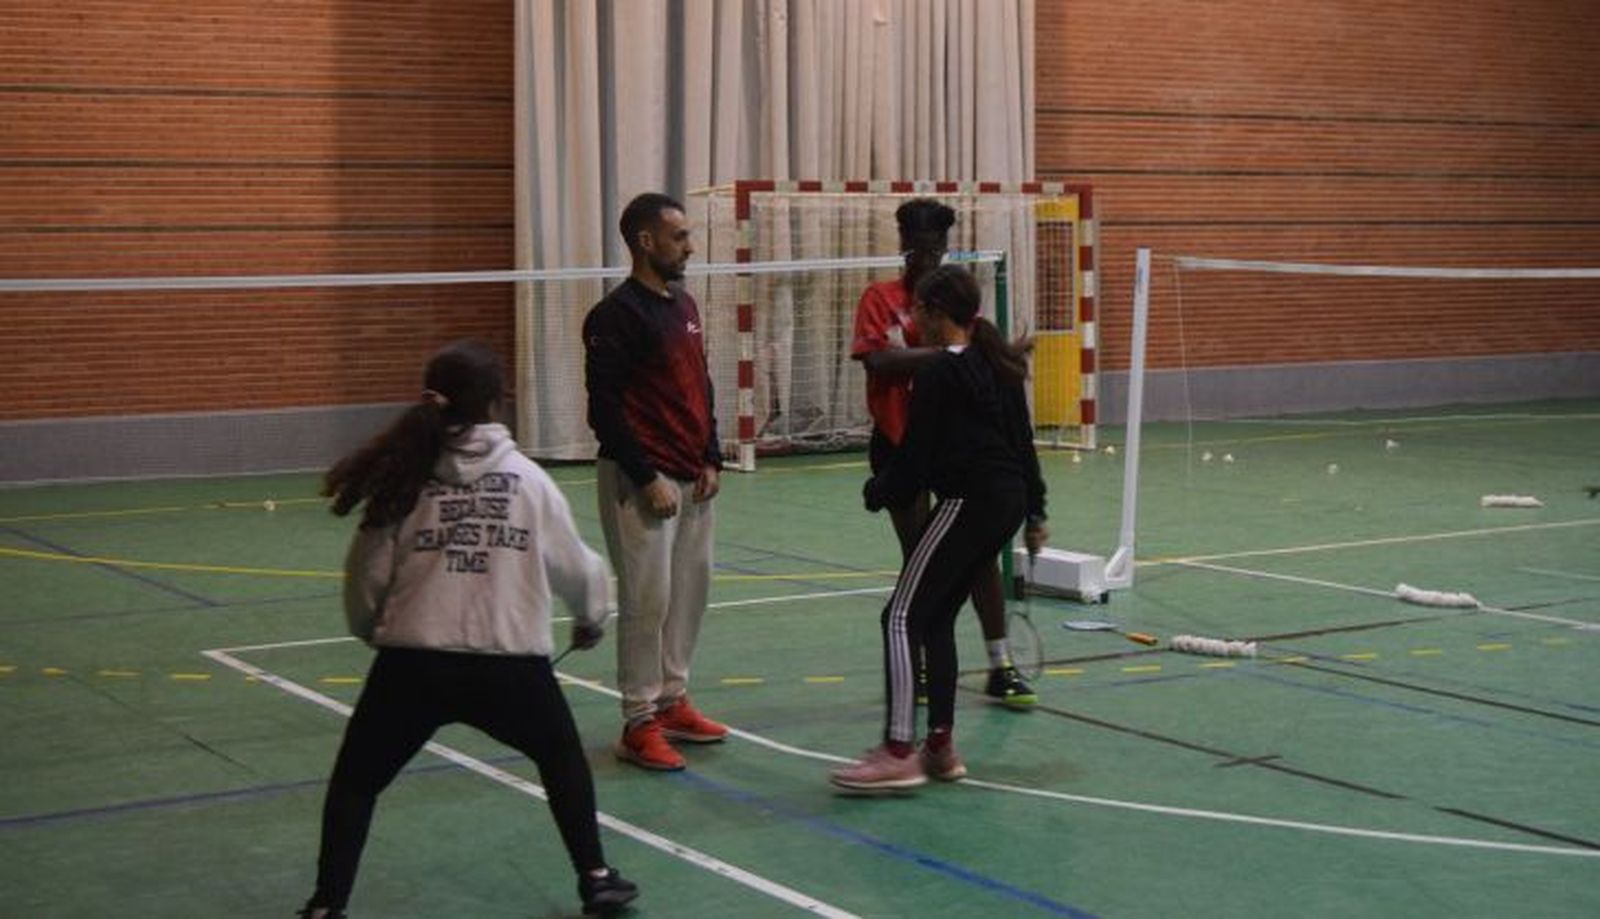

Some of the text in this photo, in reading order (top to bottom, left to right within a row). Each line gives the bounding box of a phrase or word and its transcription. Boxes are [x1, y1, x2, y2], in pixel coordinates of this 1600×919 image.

[438, 496, 509, 522] BECAUSE
[414, 522, 529, 552] CHANGES TAKE
[445, 549, 489, 573] TIME
